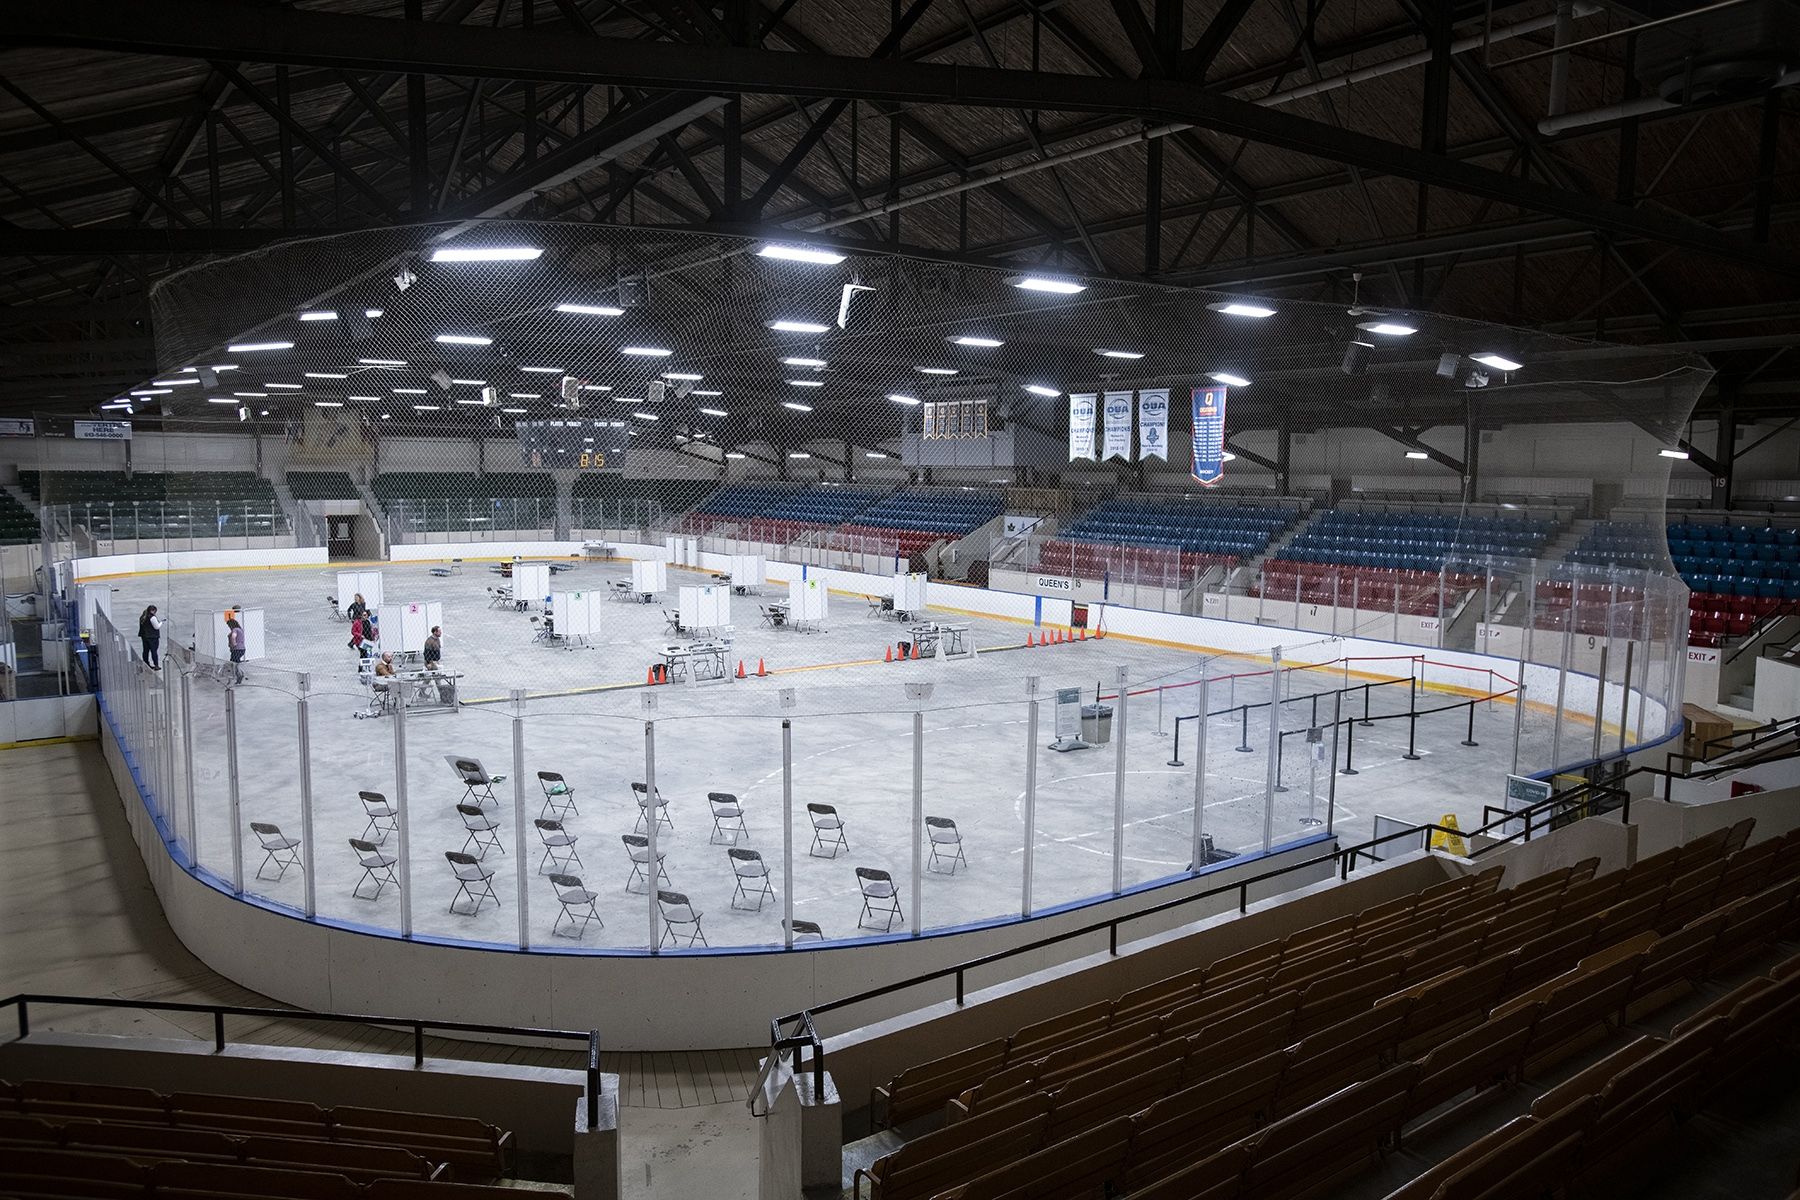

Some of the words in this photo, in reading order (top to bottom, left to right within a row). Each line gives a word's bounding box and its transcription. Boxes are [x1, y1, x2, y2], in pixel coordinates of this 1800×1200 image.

[1107, 405, 1129, 413] OUA
[1142, 402, 1166, 410] OUA
[1715, 478, 1726, 488] 19
[1039, 578, 1069, 590] QUEEN'S
[1421, 621, 1434, 629] EXIT
[1479, 629, 1494, 637] EXT
[1688, 651, 1707, 662] EXIT
